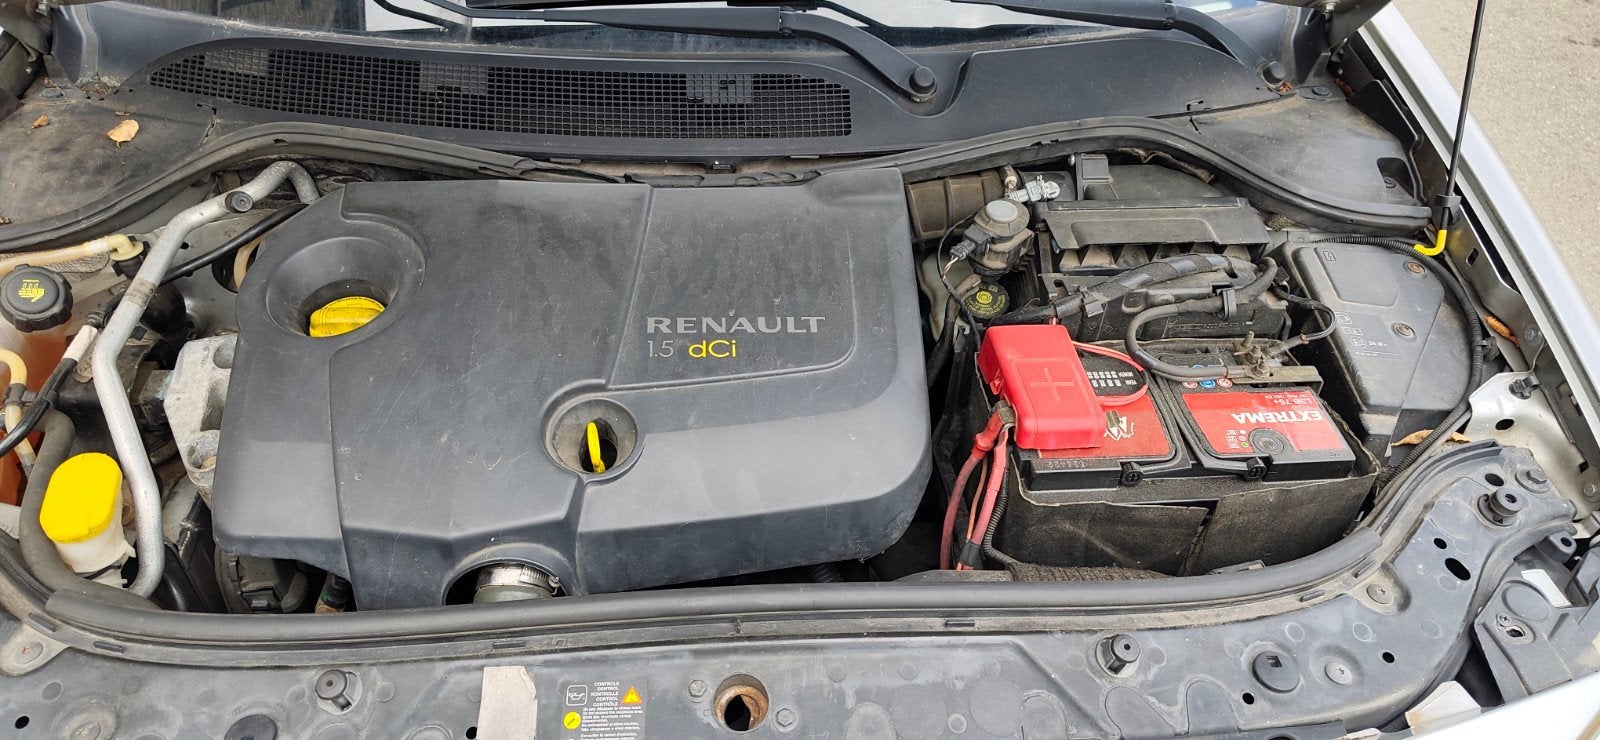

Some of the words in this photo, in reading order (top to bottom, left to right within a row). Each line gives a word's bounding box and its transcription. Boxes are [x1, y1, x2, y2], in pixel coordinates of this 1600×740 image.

[646, 316, 826, 334] RENAULT
[647, 340, 674, 358] 1.5
[688, 339, 737, 358] dCi
[1230, 410, 1323, 424] EXTREMA
